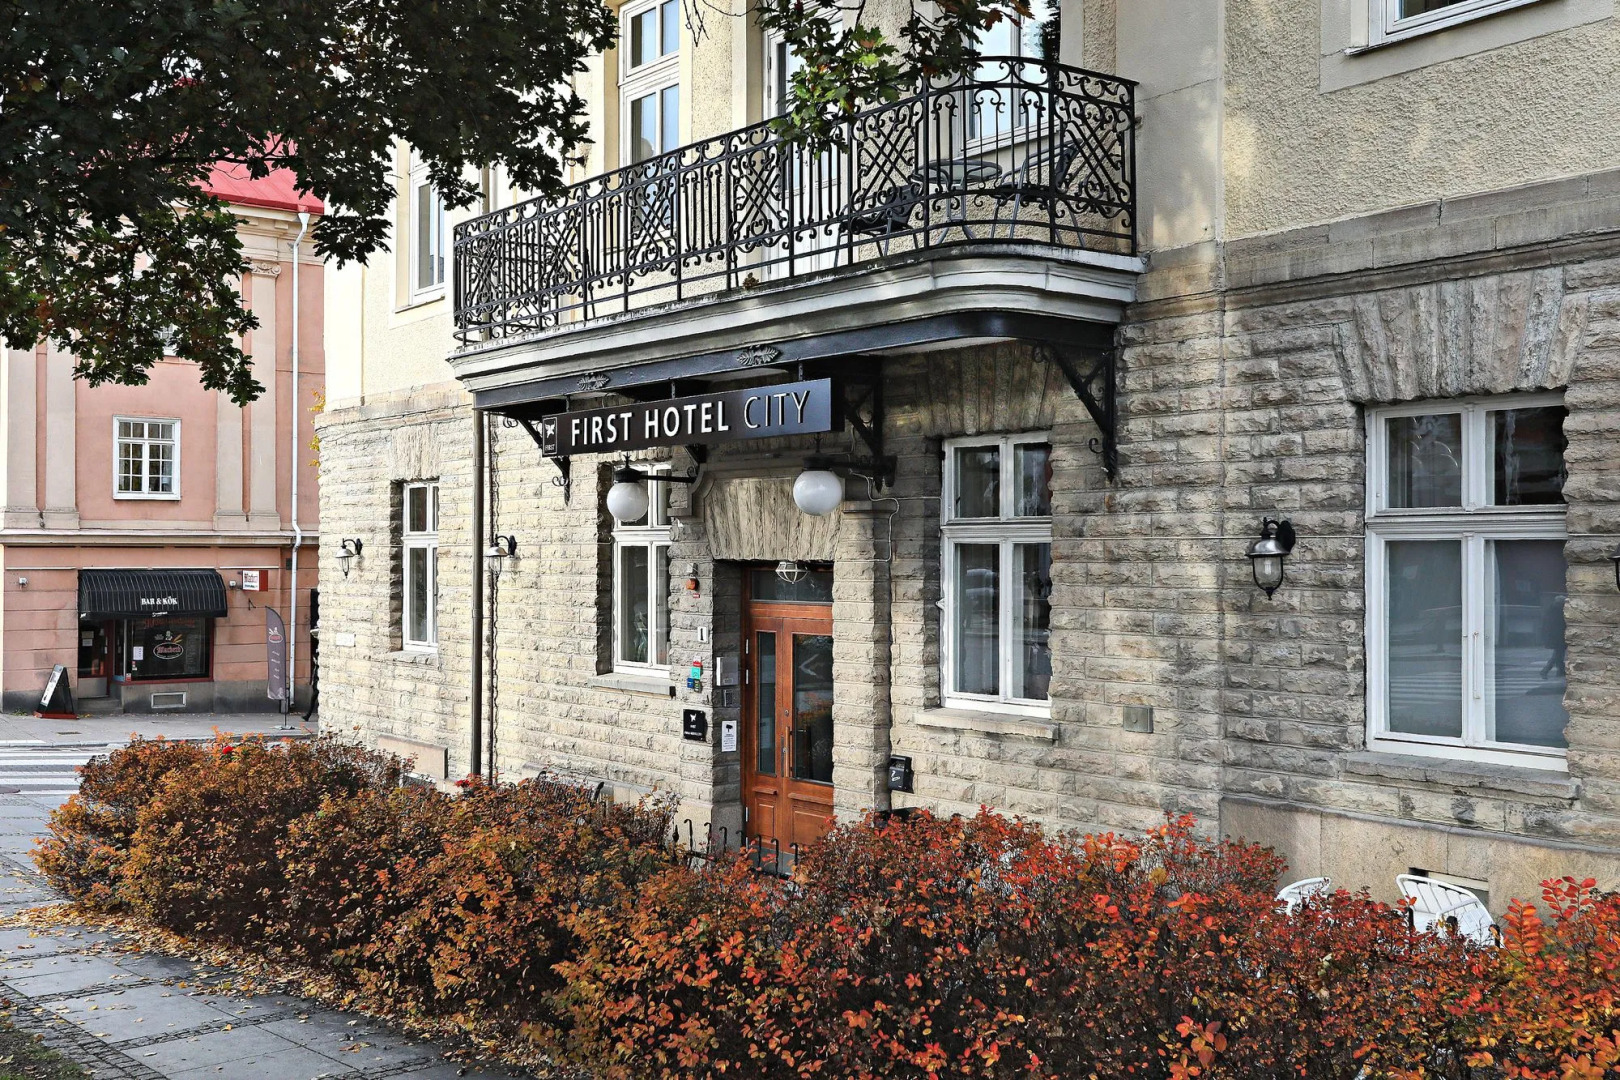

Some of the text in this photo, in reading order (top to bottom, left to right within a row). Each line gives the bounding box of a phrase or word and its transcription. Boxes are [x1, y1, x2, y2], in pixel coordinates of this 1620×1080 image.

[571, 390, 811, 446] FIRST HOTEL CITY
[141, 597, 155, 606] BAR
[156, 597, 162, 605] &
